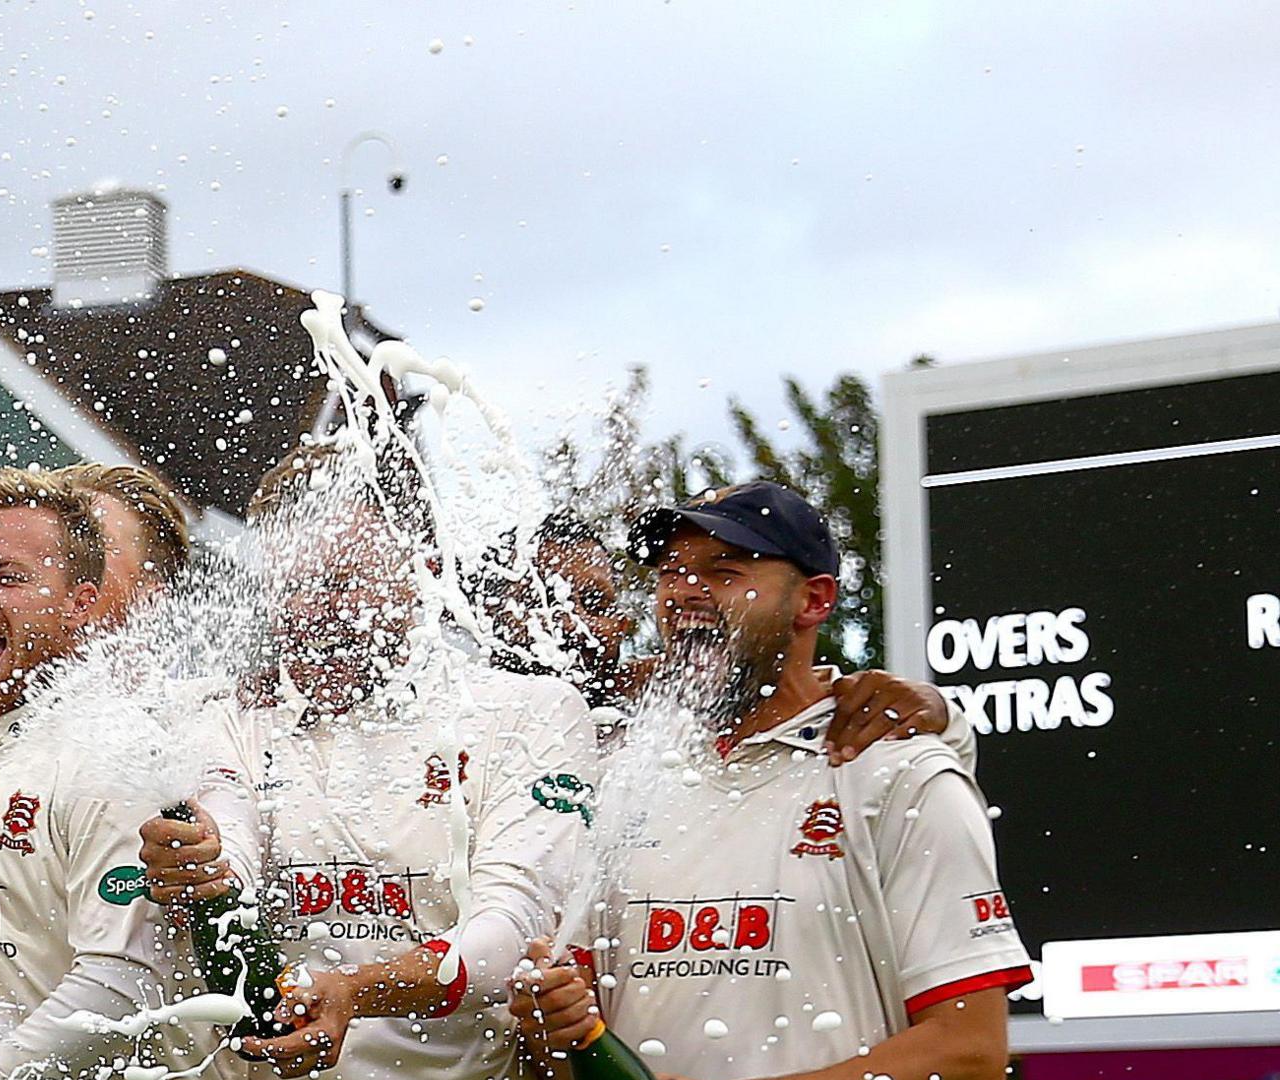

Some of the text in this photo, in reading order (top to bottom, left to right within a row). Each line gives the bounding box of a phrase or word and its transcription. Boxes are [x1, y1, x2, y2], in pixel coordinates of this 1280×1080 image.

[927, 608, 1089, 674] OVERS
[296, 868, 411, 919] D&B
[647, 905, 770, 953] D&B
[631, 959, 749, 979] CAFFOLDING
